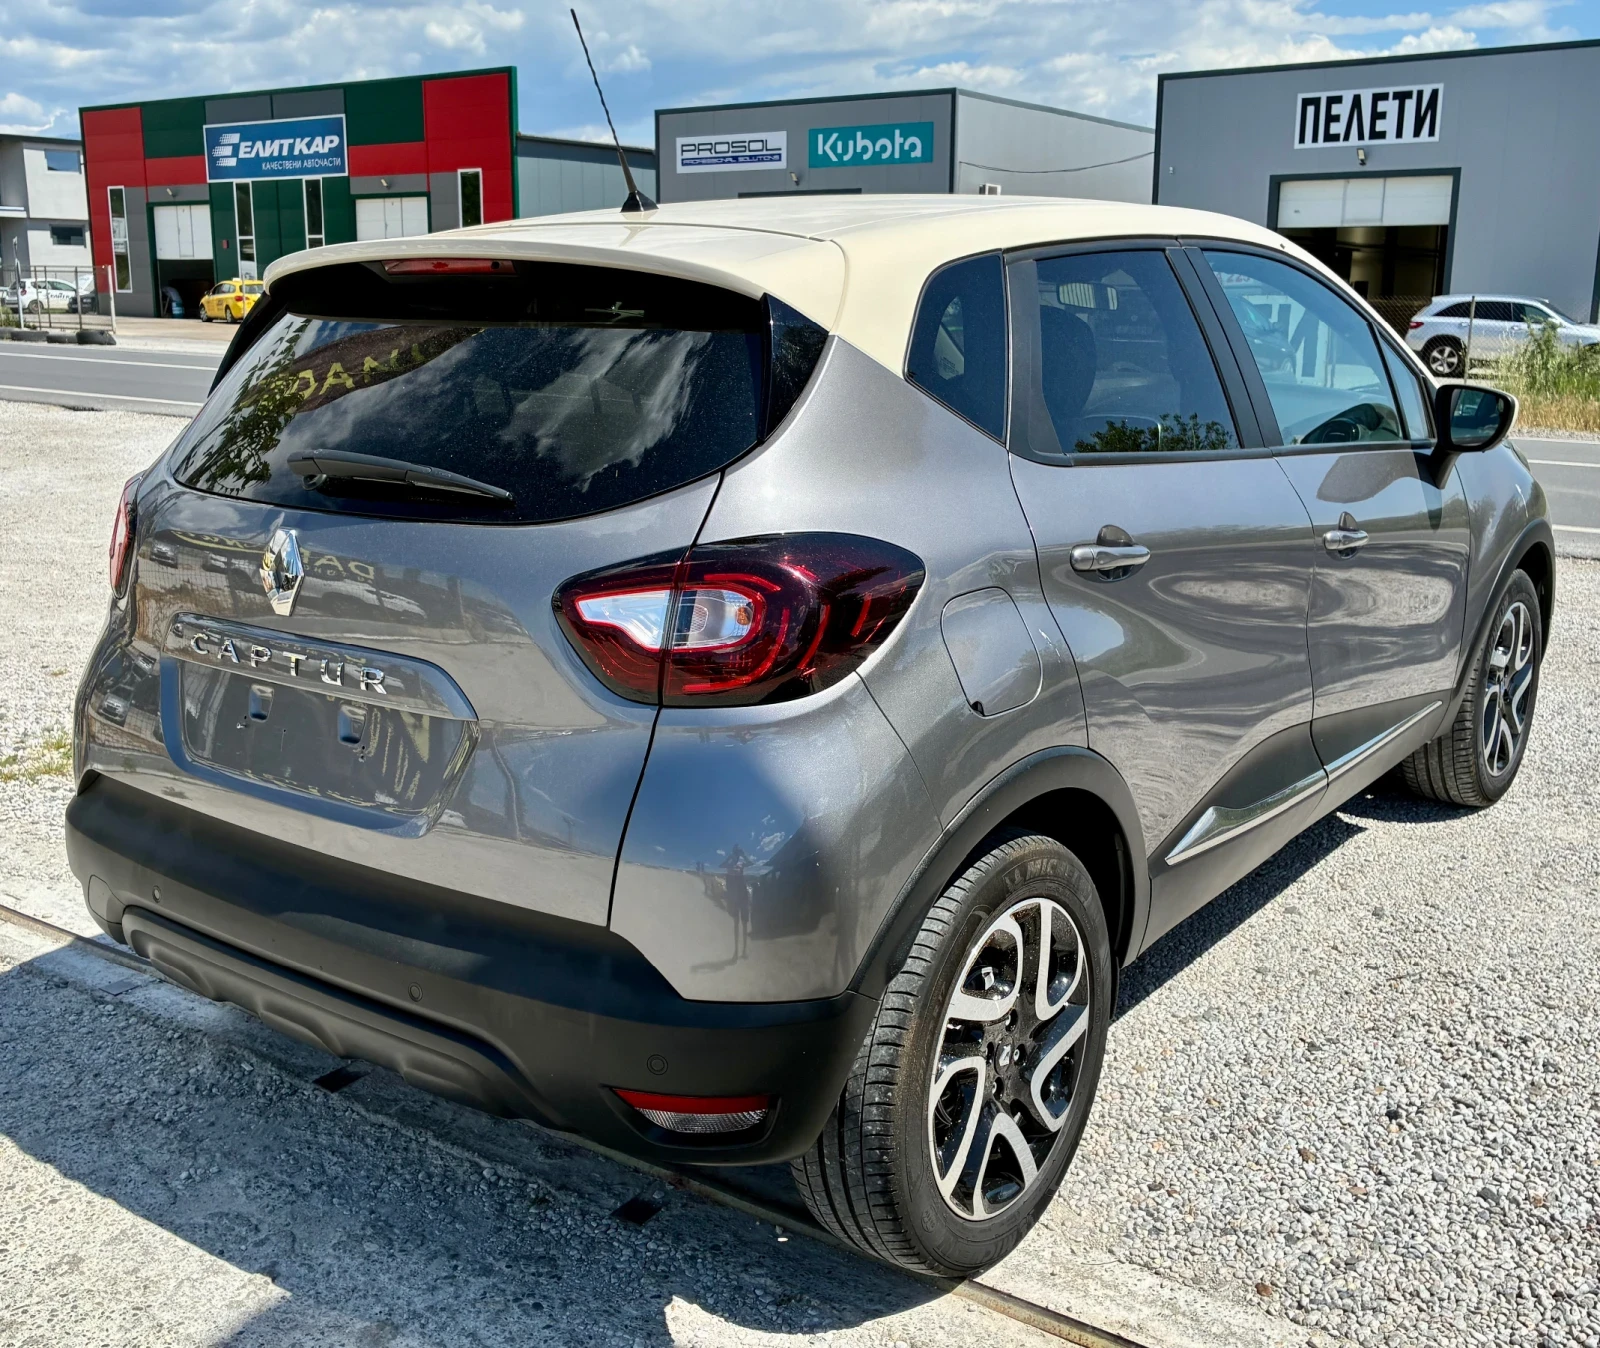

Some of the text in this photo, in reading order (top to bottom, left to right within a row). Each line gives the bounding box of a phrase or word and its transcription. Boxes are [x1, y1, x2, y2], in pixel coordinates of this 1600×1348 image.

[1298, 88, 1440, 145] ПЕЛЕТИ
[681, 139, 782, 156] PROSOL
[817, 129, 922, 161] Kubota
[262, 157, 341, 170] КАЧЕСТВЕНИ АВТОЧАСТИ
[737, 154, 780, 162] SOLUTIONS
[190, 633, 387, 695] CAPTUR
